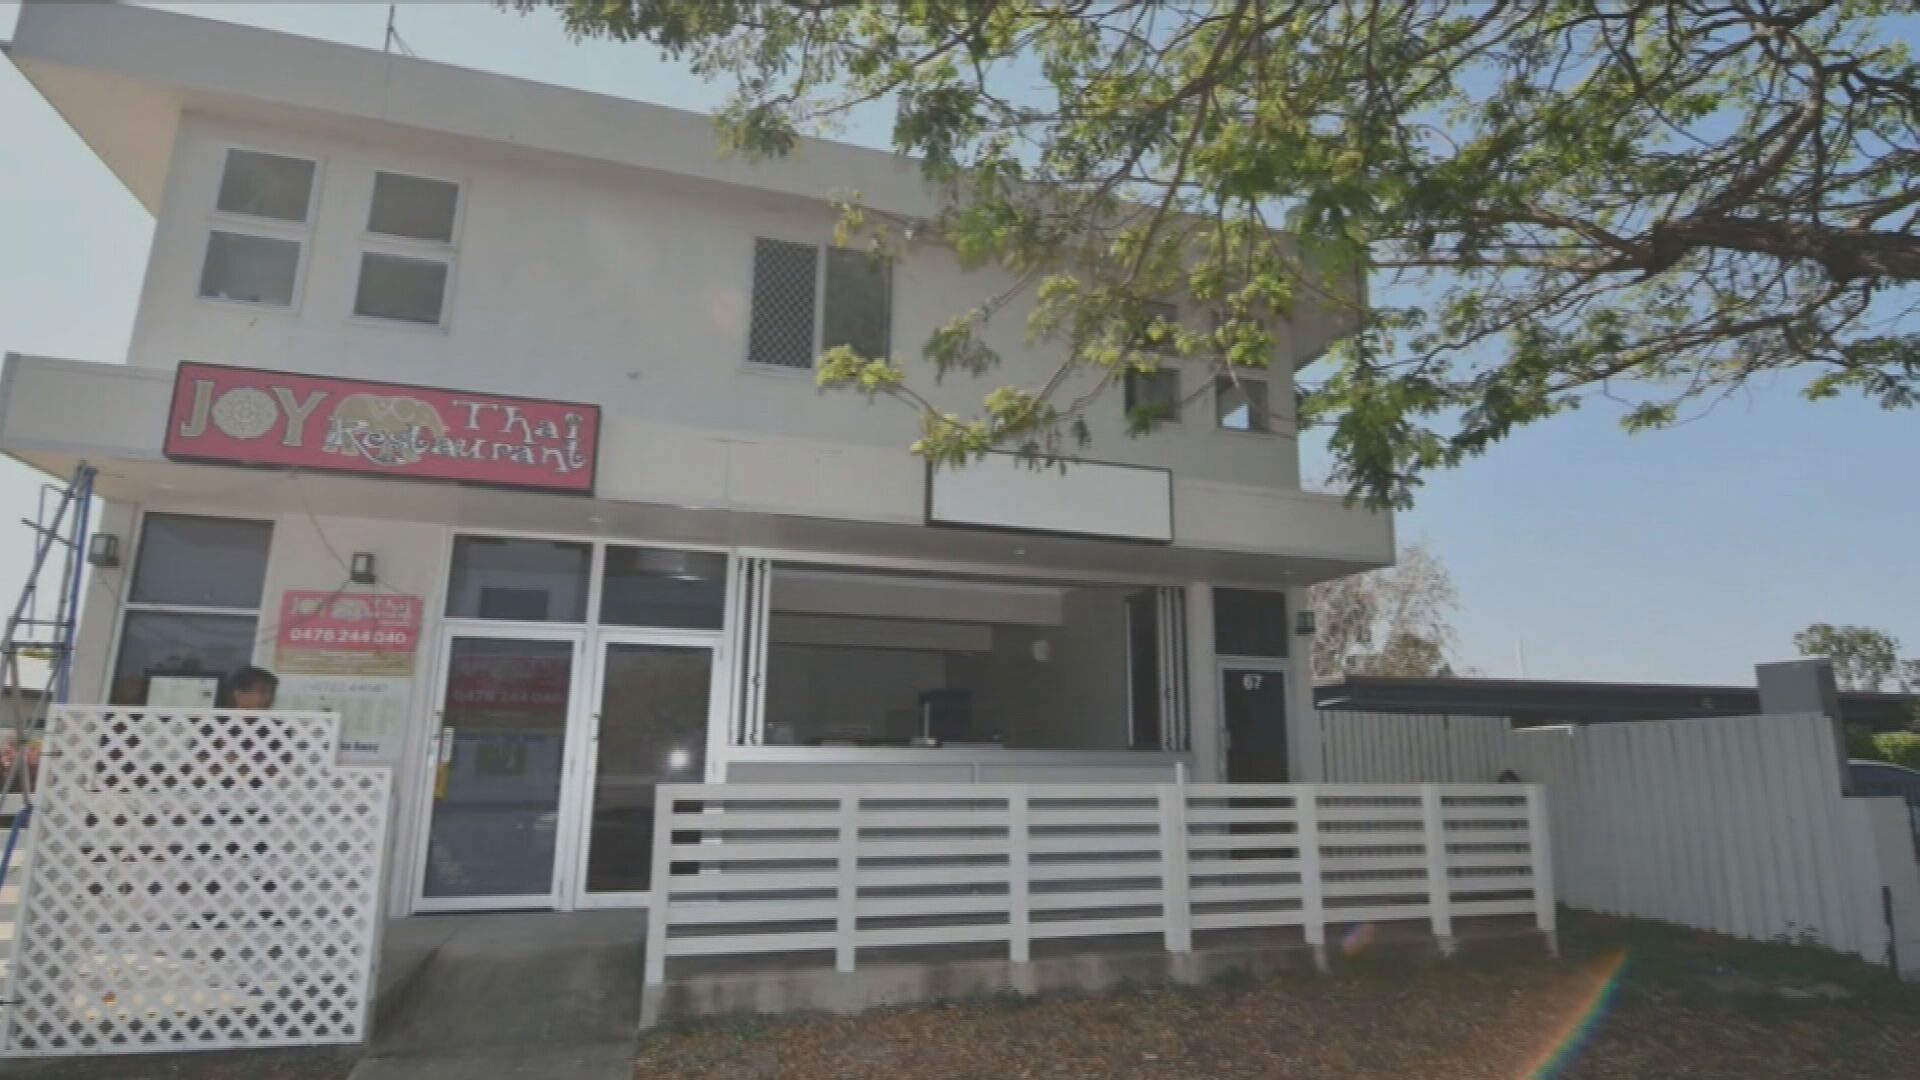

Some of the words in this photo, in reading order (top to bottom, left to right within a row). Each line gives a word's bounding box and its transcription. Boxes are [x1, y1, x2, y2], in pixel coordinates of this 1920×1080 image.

[180, 379, 329, 447] JOY
[452, 400, 585, 442] Thai
[325, 416, 587, 473] Restaurant
[1243, 673, 1264, 691] 67
